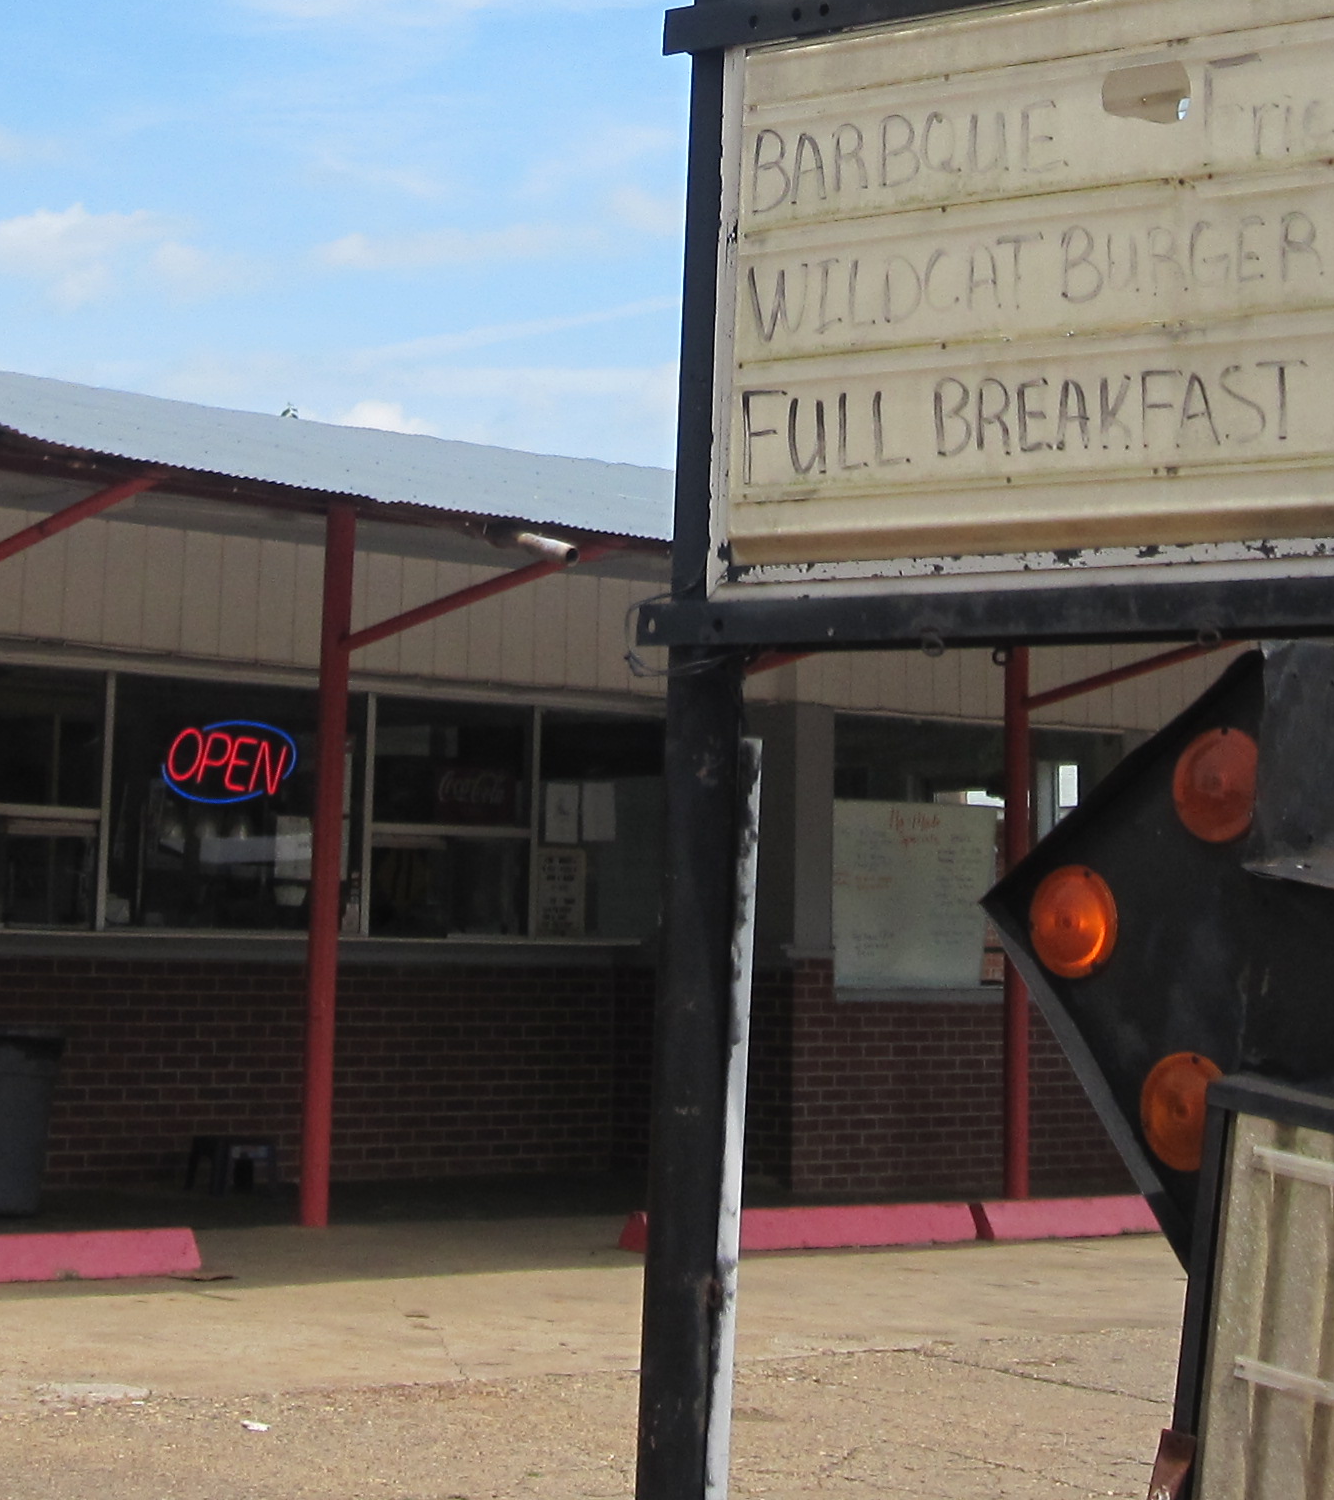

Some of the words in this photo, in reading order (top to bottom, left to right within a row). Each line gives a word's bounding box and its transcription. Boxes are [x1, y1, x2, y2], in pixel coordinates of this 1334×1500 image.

[751, 100, 1069, 214] BARBQUE
[747, 231, 1045, 343] WILDCAT
[1060, 208, 1325, 302] BURGER
[741, 389, 912, 485] FULL
[933, 360, 1308, 457] BREAKFAST
[167, 727, 289, 796] OPEN
